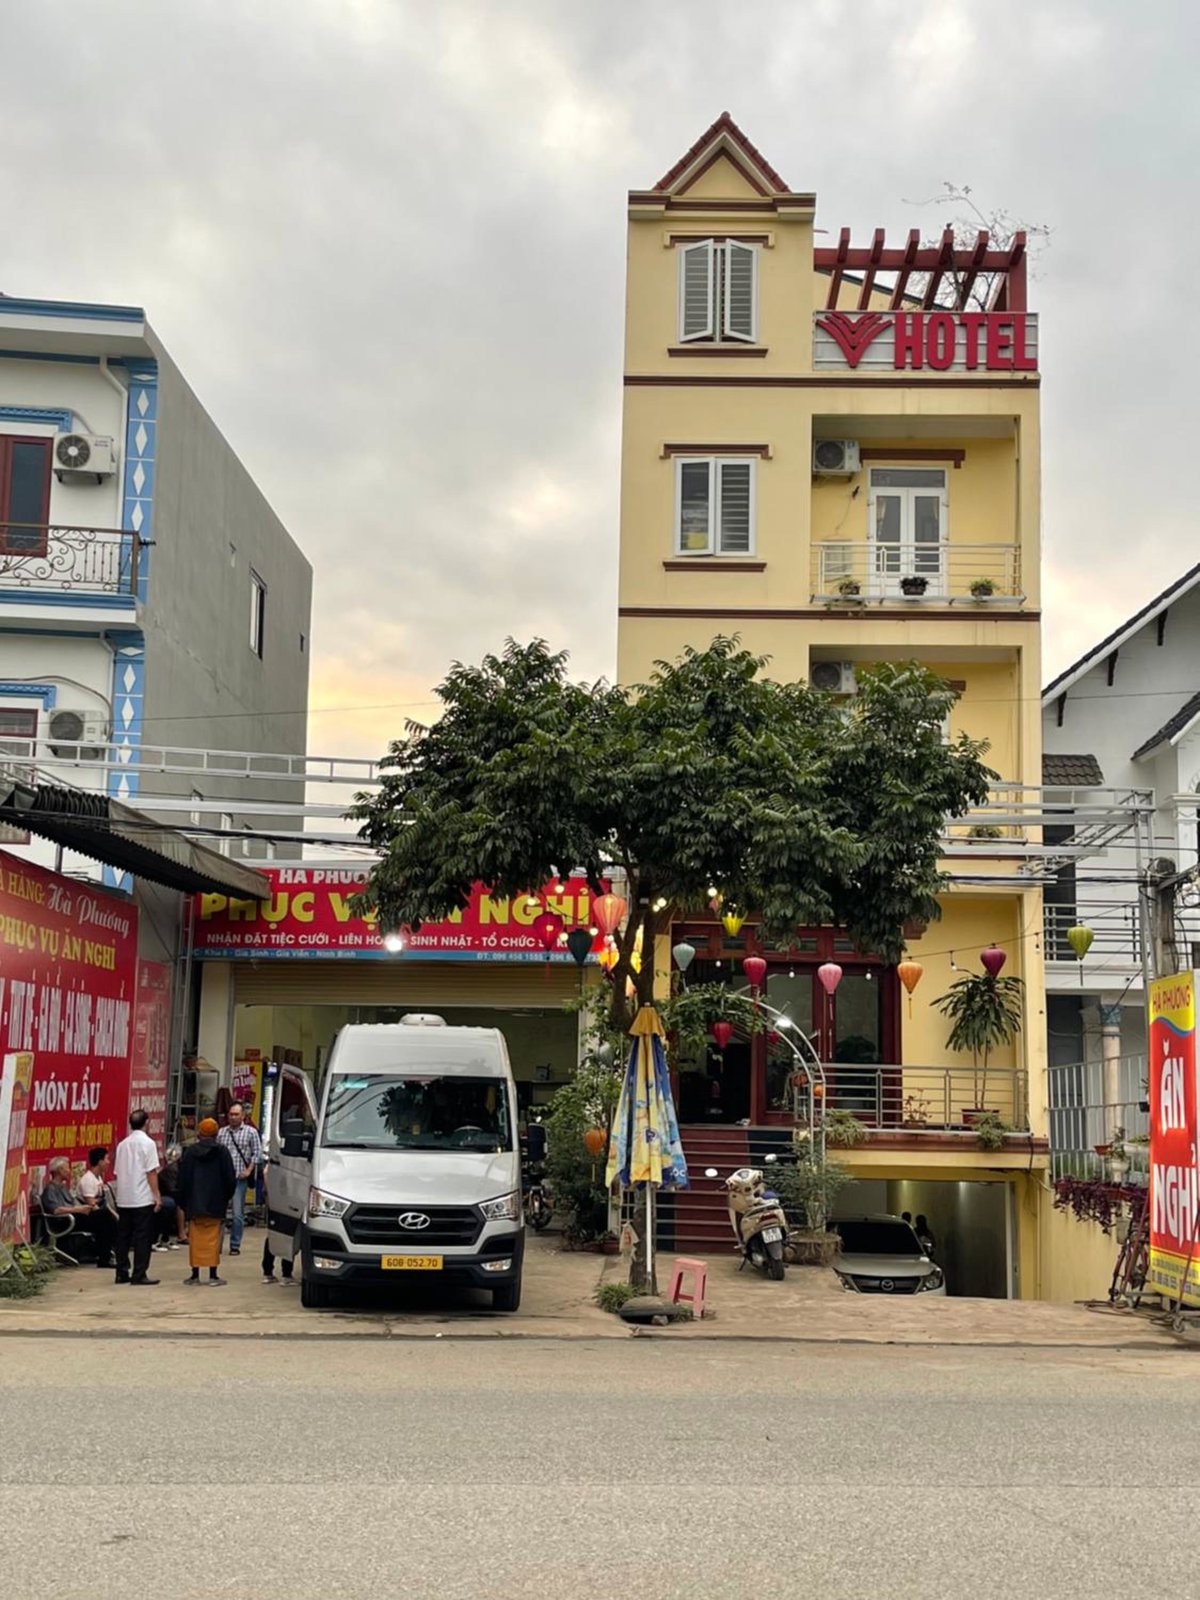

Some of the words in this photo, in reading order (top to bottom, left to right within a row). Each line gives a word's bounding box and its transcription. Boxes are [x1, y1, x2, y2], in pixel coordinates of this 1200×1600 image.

[894, 312, 1038, 370] HOTEL
[200, 892, 315, 930] PHỤC
[207, 931, 241, 947] NHẬN
[270, 932, 296, 947] TIỆC
[339, 933, 362, 945] LIÊN
[410, 935, 438, 946] SINH
[500, 934, 536, 948] CHỨC
[33, 1071, 70, 1111] MÓN
[1160, 1038, 1187, 1136] ĂN
